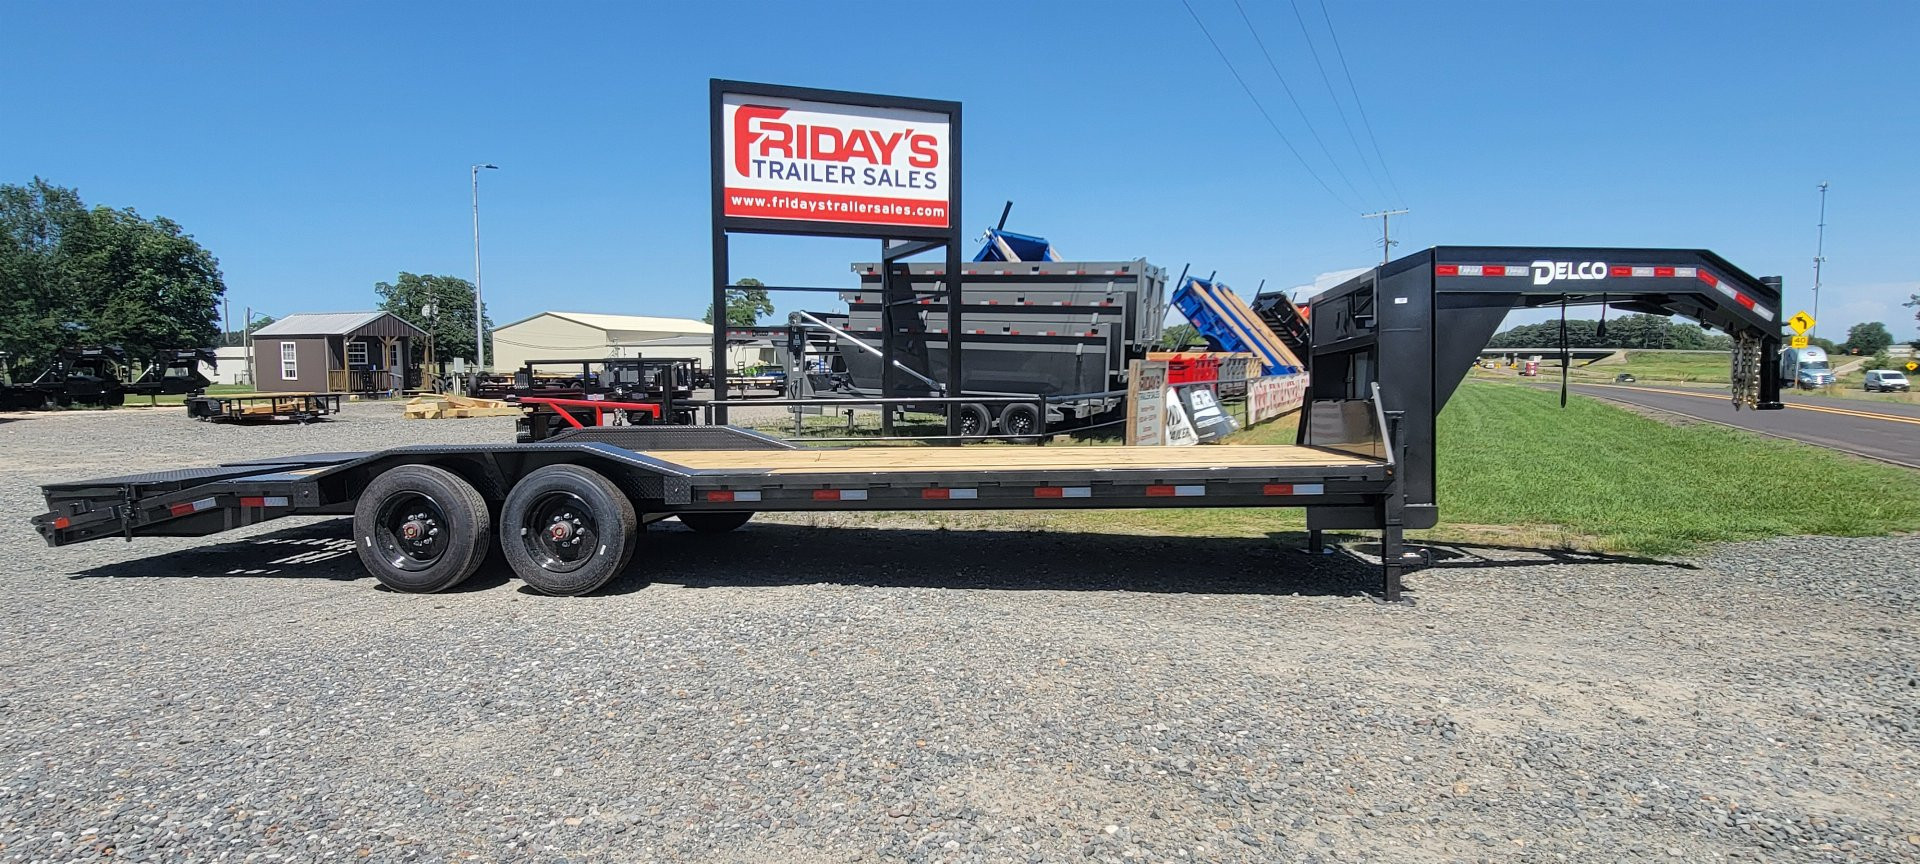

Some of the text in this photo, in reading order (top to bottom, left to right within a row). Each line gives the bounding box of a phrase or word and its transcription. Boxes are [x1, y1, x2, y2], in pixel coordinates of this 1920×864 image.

[734, 104, 939, 178] FRIDAY'S
[752, 159, 938, 190] TRAILER SALES
[730, 194, 945, 217] www.fridaystrailersales.com
[1530, 260, 1608, 285] DELCO
